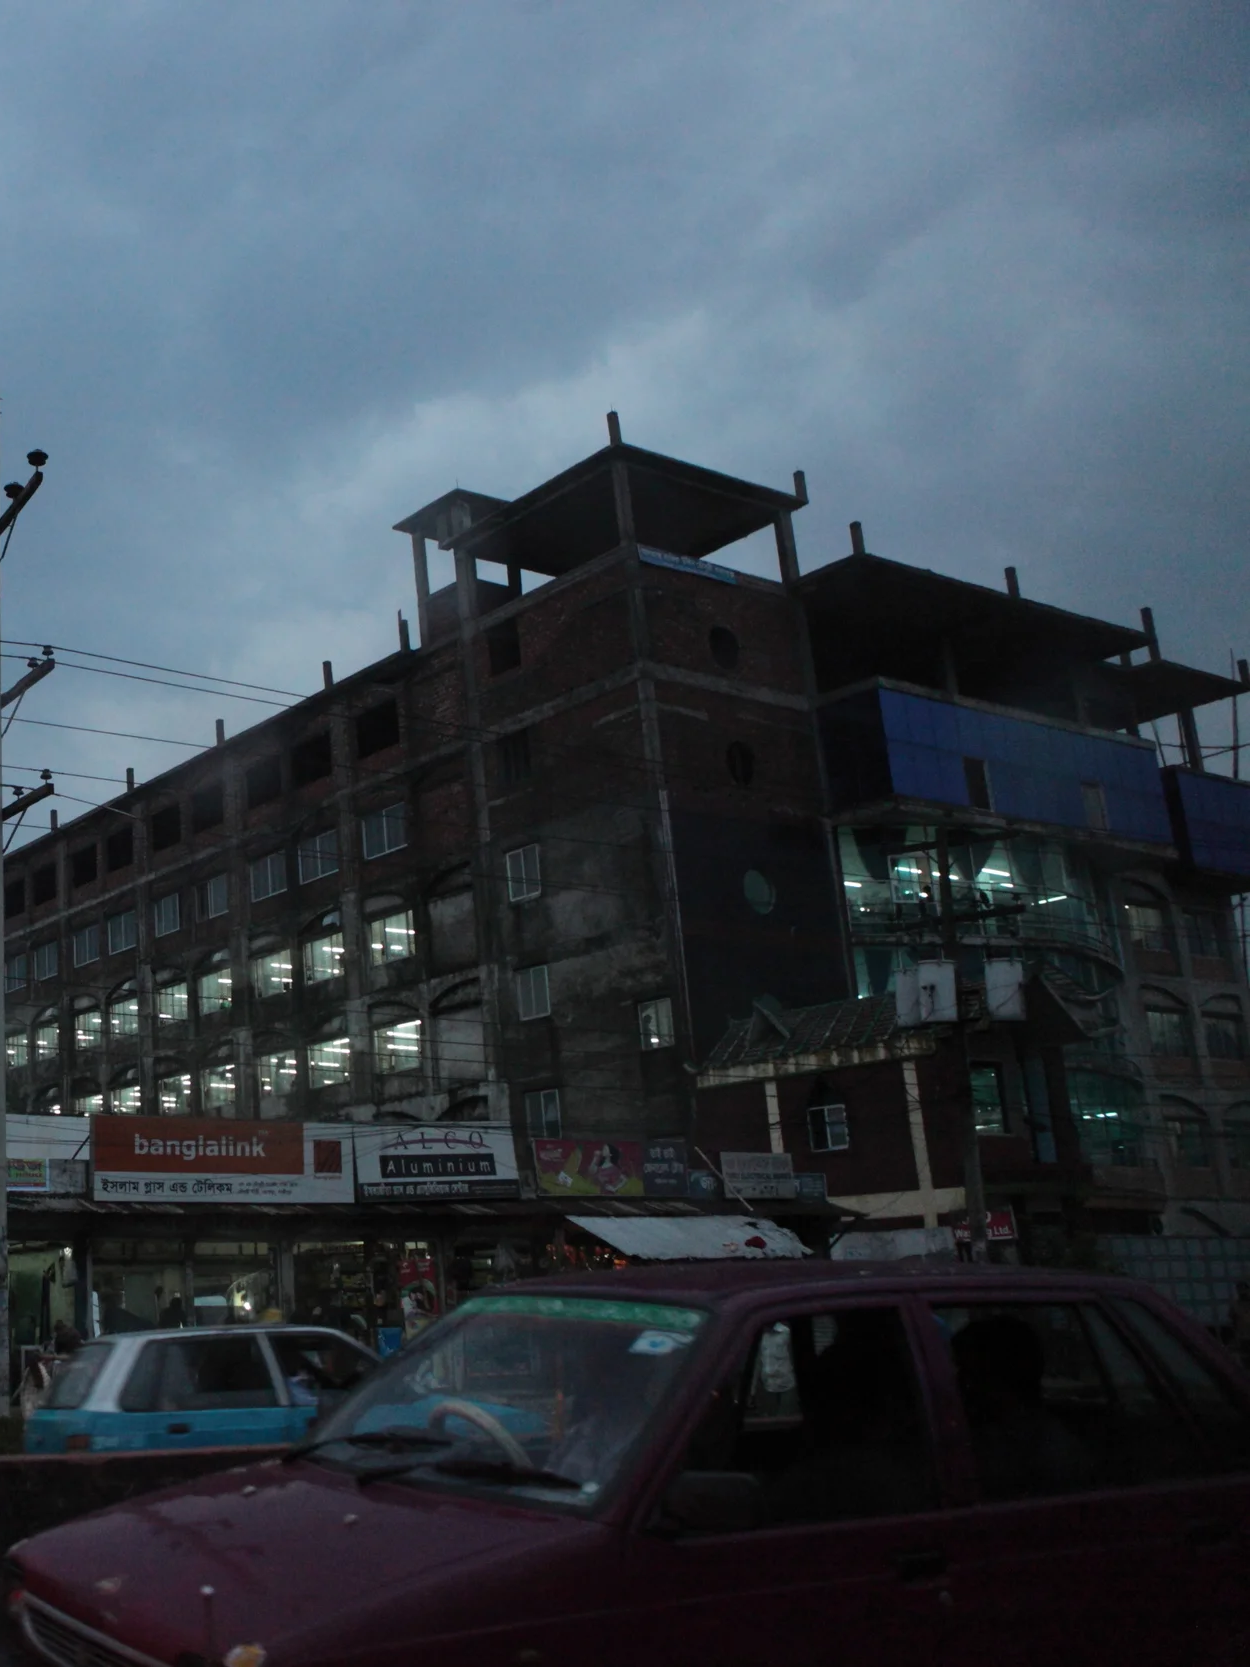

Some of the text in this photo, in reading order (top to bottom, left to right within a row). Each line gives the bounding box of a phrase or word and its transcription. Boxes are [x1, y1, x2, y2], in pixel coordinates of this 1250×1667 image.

[134, 1133, 266, 1161] banglalink
[394, 1131, 483, 1150] ALCO
[386, 1158, 491, 1174] Aluminium
[101, 1178, 139, 1193] ইসলাম
[192, 1178, 233, 1194] টেলিকম
